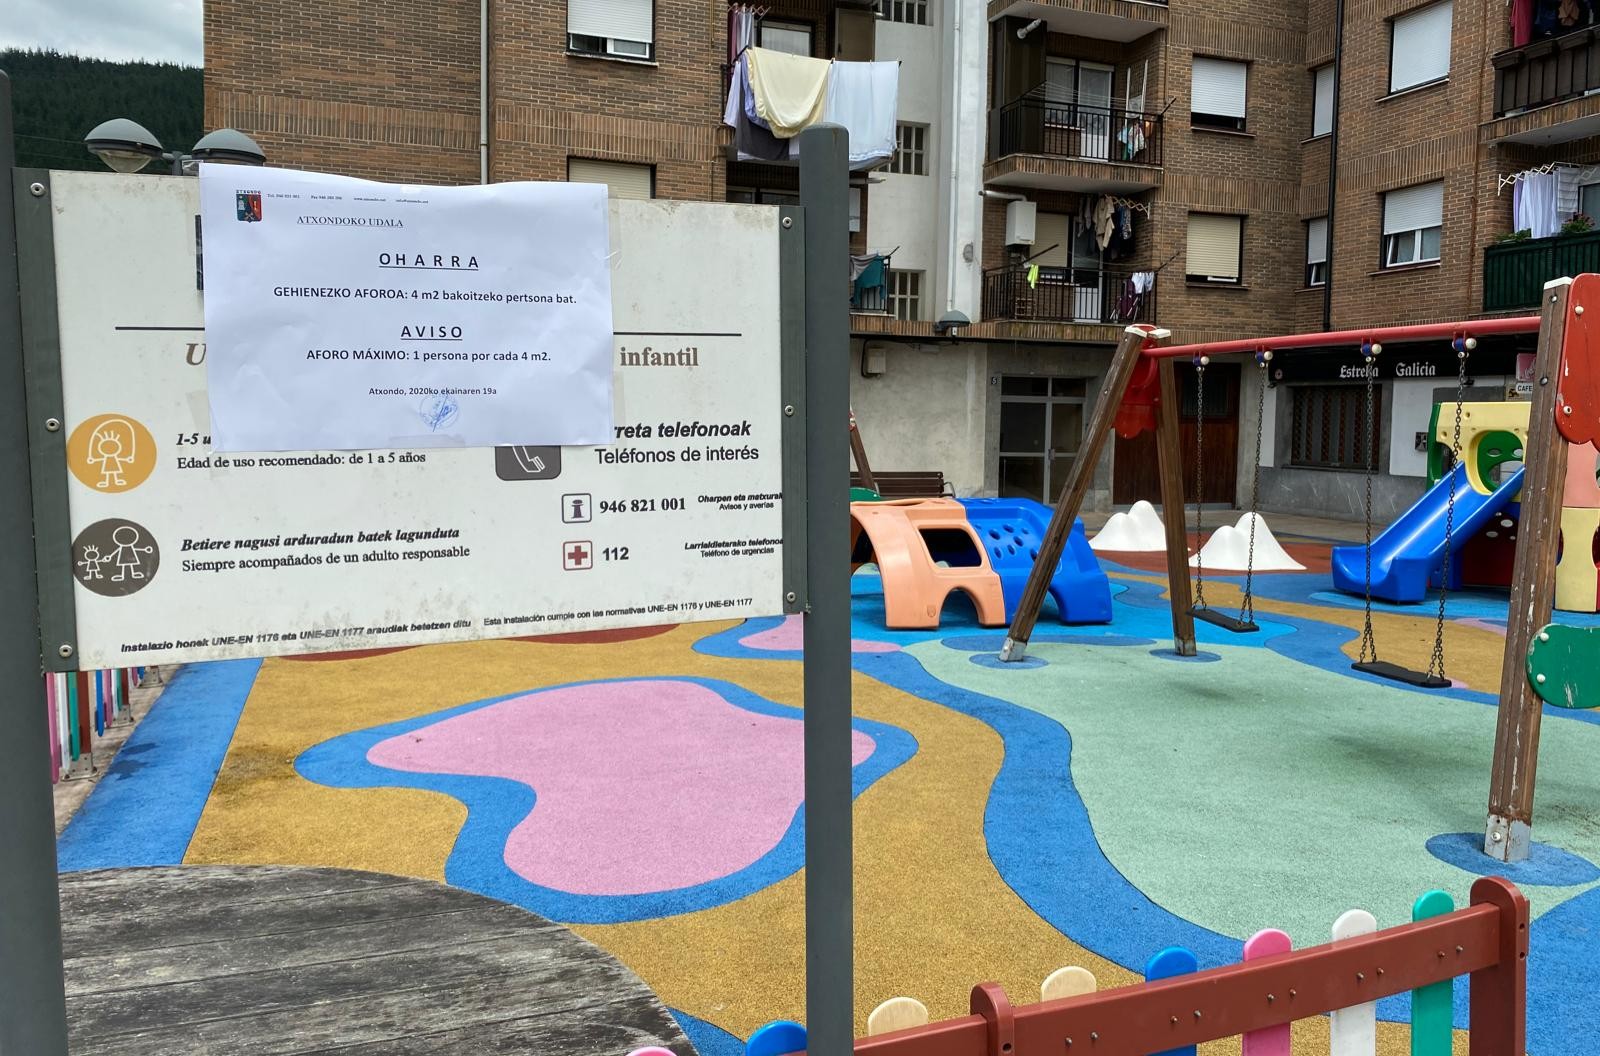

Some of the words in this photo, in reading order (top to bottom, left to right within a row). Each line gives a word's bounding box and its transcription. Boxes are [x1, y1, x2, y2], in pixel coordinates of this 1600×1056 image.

[296, 215, 366, 226] ATXONDOKO
[368, 218, 404, 228] UDALA
[379, 252, 479, 268] OHARRA
[273, 286, 352, 299] GEHIENEZKO
[354, 288, 409, 300] AFOROA:
[411, 290, 419, 300] 4
[421, 290, 440, 300] m2
[442, 290, 504, 302] bakoitzeko
[505, 293, 554, 305] pertsona
[556, 294, 577, 304] bat.
[400, 325, 463, 339] AVISO
[306, 349, 350, 361] AFORO
[352, 346, 410, 361] MÁXIMO:
[413, 349, 420, 361] 1
[422, 350, 469, 364] persona
[471, 352, 491, 365] por
[493, 350, 518, 362] cada
[521, 350, 528, 361] 4
[531, 350, 552, 362] m2.
[620, 346, 699, 367] infantil
[1395, 361, 1436, 377] Galicia
[368, 387, 407, 397] Atxondo,
[408, 386, 439, 396] 2020ko
[440, 386, 481, 396] ekainaren
[482, 386, 497, 396] 19a
[614, 423, 652, 438] reta
[658, 420, 751, 438] telefonoak
[176, 433, 199, 445] 1-5
[177, 457, 210, 469] Edad
[214, 456, 230, 468] de
[233, 458, 255, 468] uso
[258, 454, 345, 467] recomendado:
[349, 453, 365, 464] de
[368, 453, 373, 464] 1
[377, 456, 385, 464] a
[388, 452, 396, 463] 5
[399, 452, 426, 463] años
[594, 447, 675, 464] Teléfonos
[681, 447, 701, 462] de
[706, 445, 759, 461] interés
[600, 500, 627, 513] 946
[630, 499, 656, 512] 821
[661, 498, 686, 511] 001
[698, 495, 732, 504] Oharpen
[749, 501, 774, 509] averías
[181, 539, 231, 551] Betiere
[234, 537, 280, 551] nagusi
[283, 533, 354, 547] arduradun
[357, 530, 393, 543] batek
[396, 527, 460, 543] lagunduta
[684, 540, 747, 550] Larrialdietarako
[182, 560, 236, 573] Siempre
[239, 553, 323, 569] acompañados
[325, 553, 340, 564] de
[344, 553, 359, 563] un
[362, 550, 399, 563] adulto
[402, 546, 470, 561] responsable
[602, 547, 629, 561] 112
[700, 549, 730, 558] Teléfono
[741, 547, 774, 556] urgencias
[484, 618, 501, 626] Esta
[504, 613, 545, 625] instalación
[547, 611, 575, 622] cumple
[577, 611, 590, 619] con
[592, 609, 604, 617] las
[605, 605, 645, 616] normativas
[647, 604, 678, 613] UNE-EN
[680, 602, 697, 610] 1176
[705, 600, 735, 609] UNE-EN
[737, 598, 753, 606] 1177
[121, 641, 173, 653] Instalazio
[175, 638, 209, 649] honek
[211, 635, 253, 646] UNE-EN
[256, 633, 279, 643] 1176
[281, 632, 297, 640] eta
[300, 629, 340, 640] UNE-EN
[341, 627, 364, 637] 1177
[366, 624, 408, 635] araudiak
[410, 621, 451, 632] betetzen
[453, 619, 471, 628] ditu
